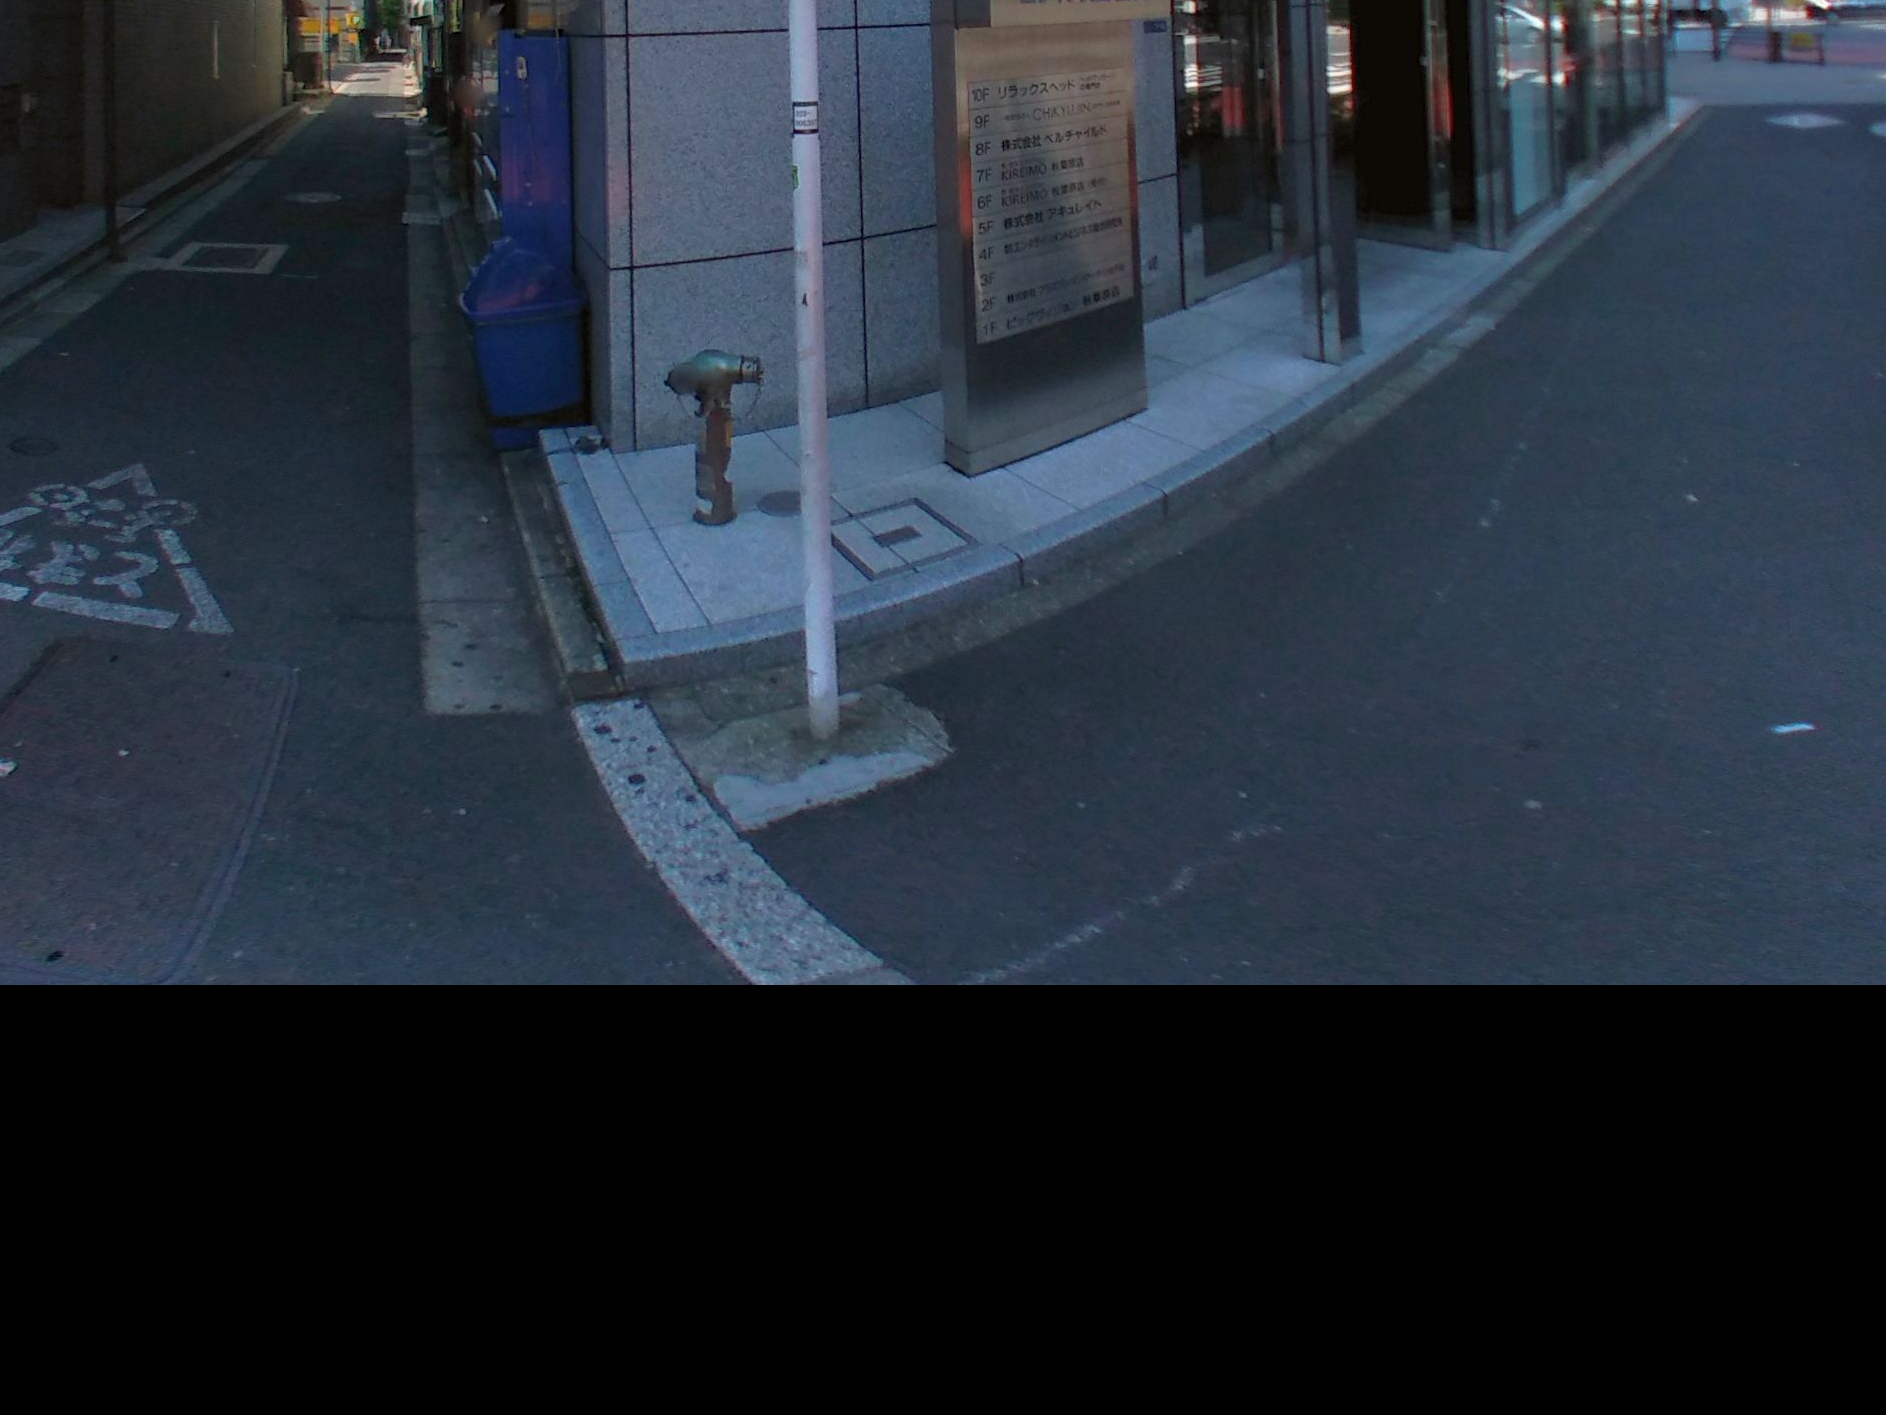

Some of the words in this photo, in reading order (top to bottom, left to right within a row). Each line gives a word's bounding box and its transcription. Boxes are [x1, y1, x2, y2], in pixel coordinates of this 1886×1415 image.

[972, 87, 990, 102] 10F
[998, 79, 1075, 99] リラックスヘッド
[974, 115, 990, 129] 9F
[975, 142, 991, 156] 8F
[1001, 135, 1042, 152] 株式会社
[976, 168, 992, 183] 7F
[977, 195, 993, 210] 6F
[978, 220, 994, 235] 5F
[1004, 211, 1044, 230] 株式会社
[979, 246, 994, 261] 4F
[980, 272, 996, 287] 3F
[981, 296, 997, 312] 2F
